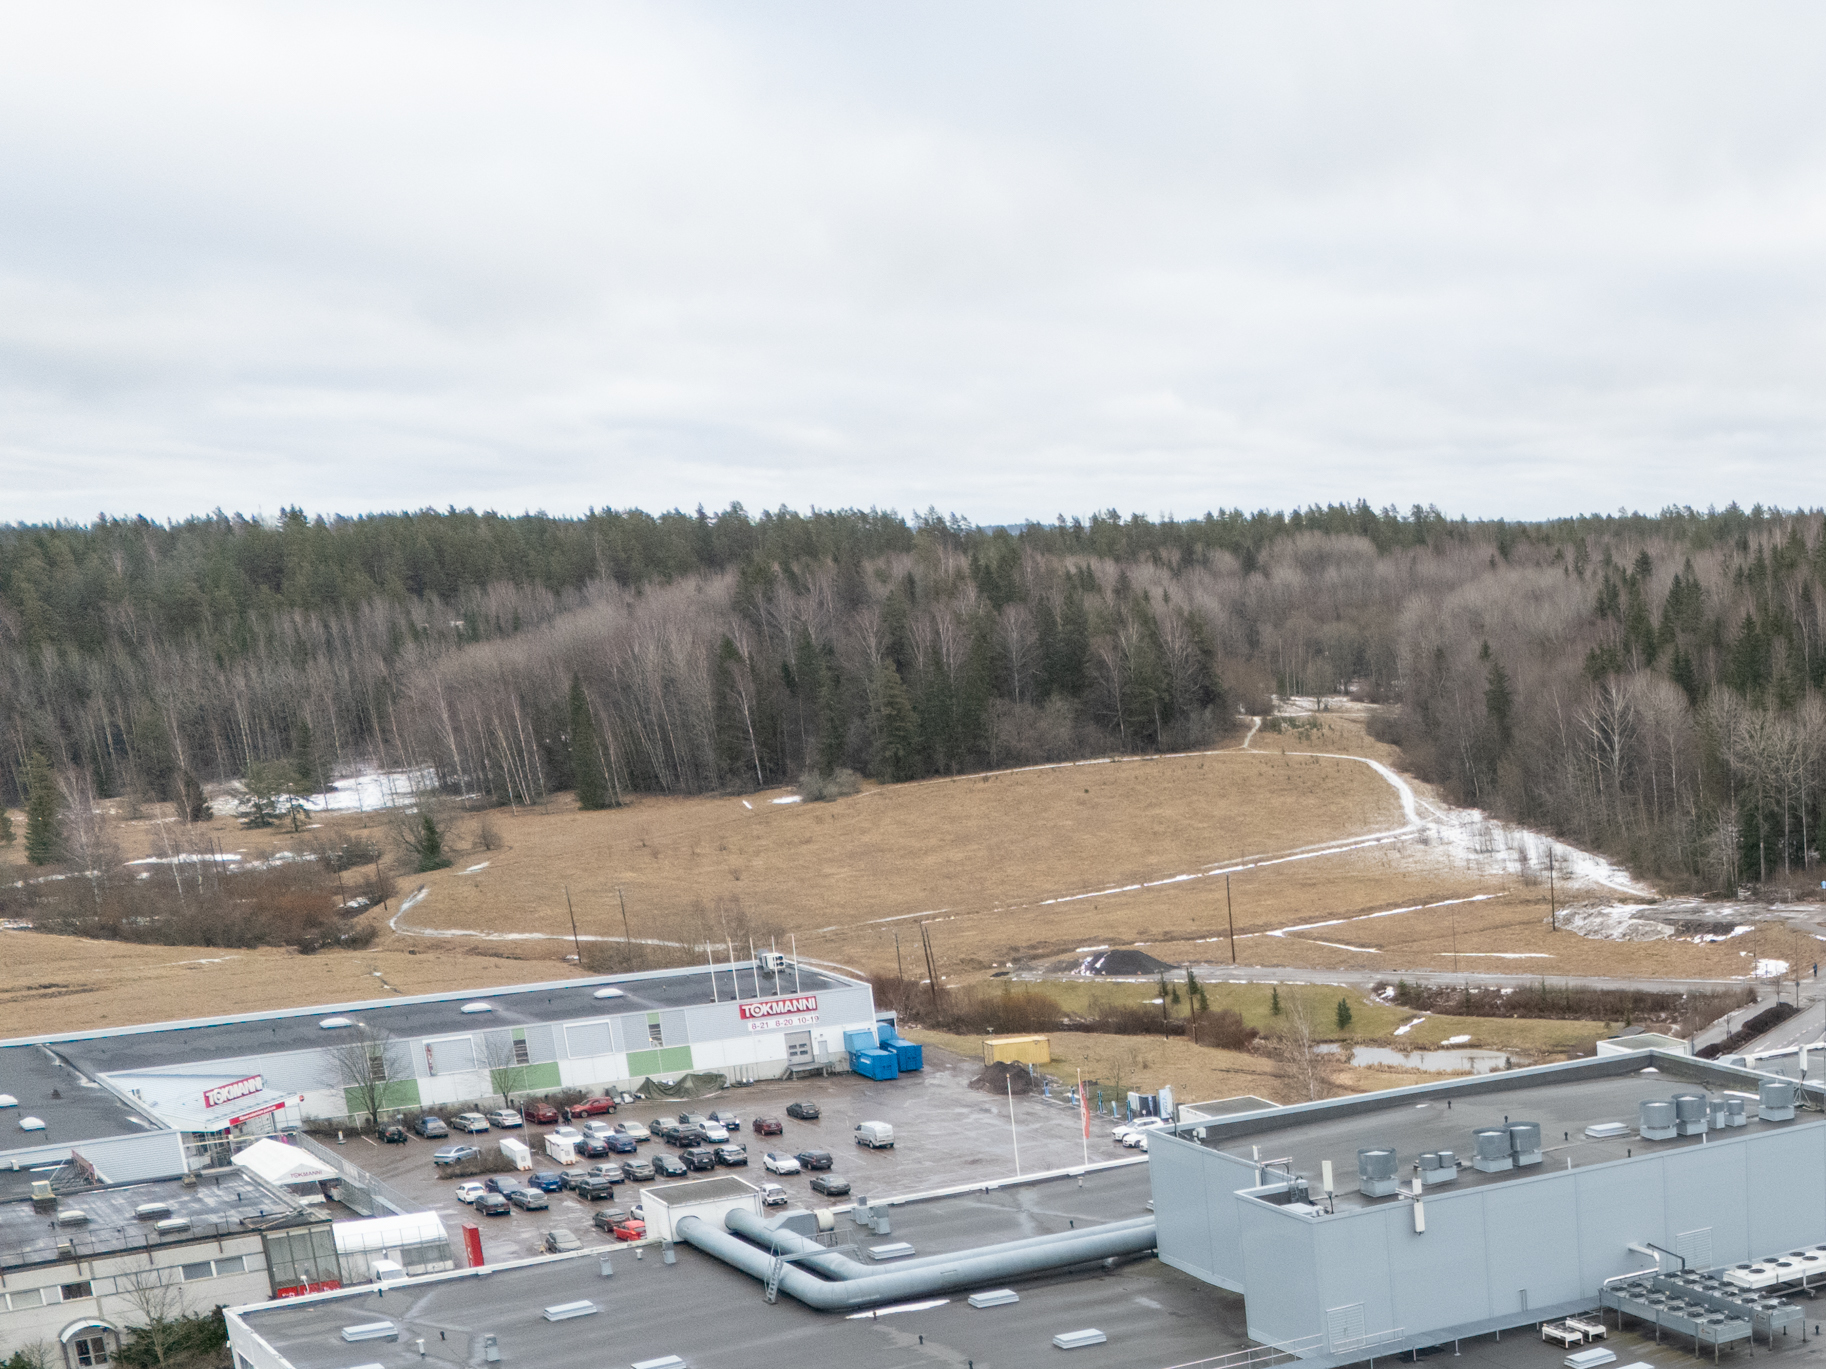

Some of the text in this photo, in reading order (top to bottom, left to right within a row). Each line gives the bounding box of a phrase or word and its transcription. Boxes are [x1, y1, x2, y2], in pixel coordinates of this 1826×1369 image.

[742, 998, 816, 1017] TOKMANNI
[752, 1016, 819, 1030] 8-21 8-20 10-19
[206, 1077, 262, 1105] TOKMANNI
[291, 1171, 322, 1179] TOKMANNI
